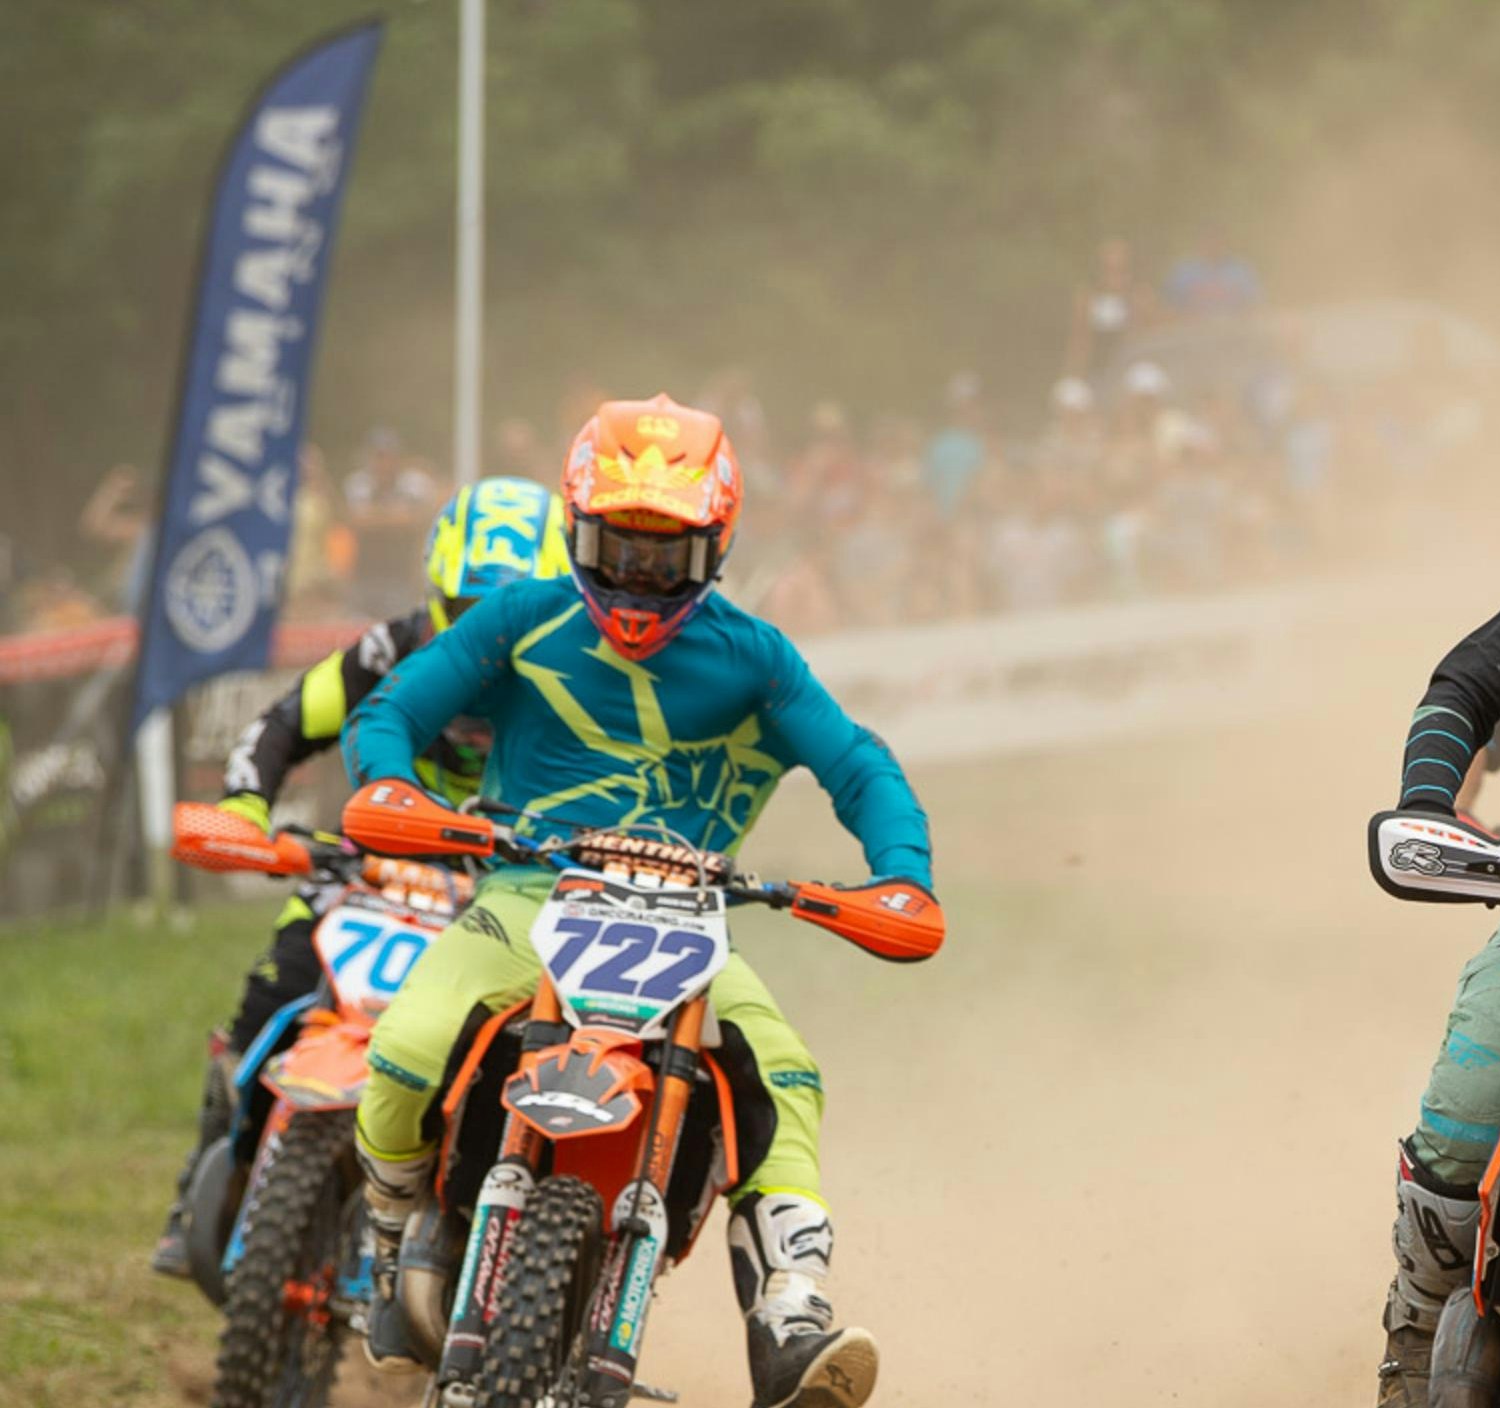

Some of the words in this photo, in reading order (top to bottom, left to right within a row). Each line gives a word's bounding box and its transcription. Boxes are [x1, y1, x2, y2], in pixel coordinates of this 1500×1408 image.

[189, 104, 342, 524] YAMAHA
[467, 477, 541, 573] FXR
[589, 484, 697, 521] adidas
[548, 918, 716, 1002] 722
[620, 1238, 656, 1324] MOTOREX
